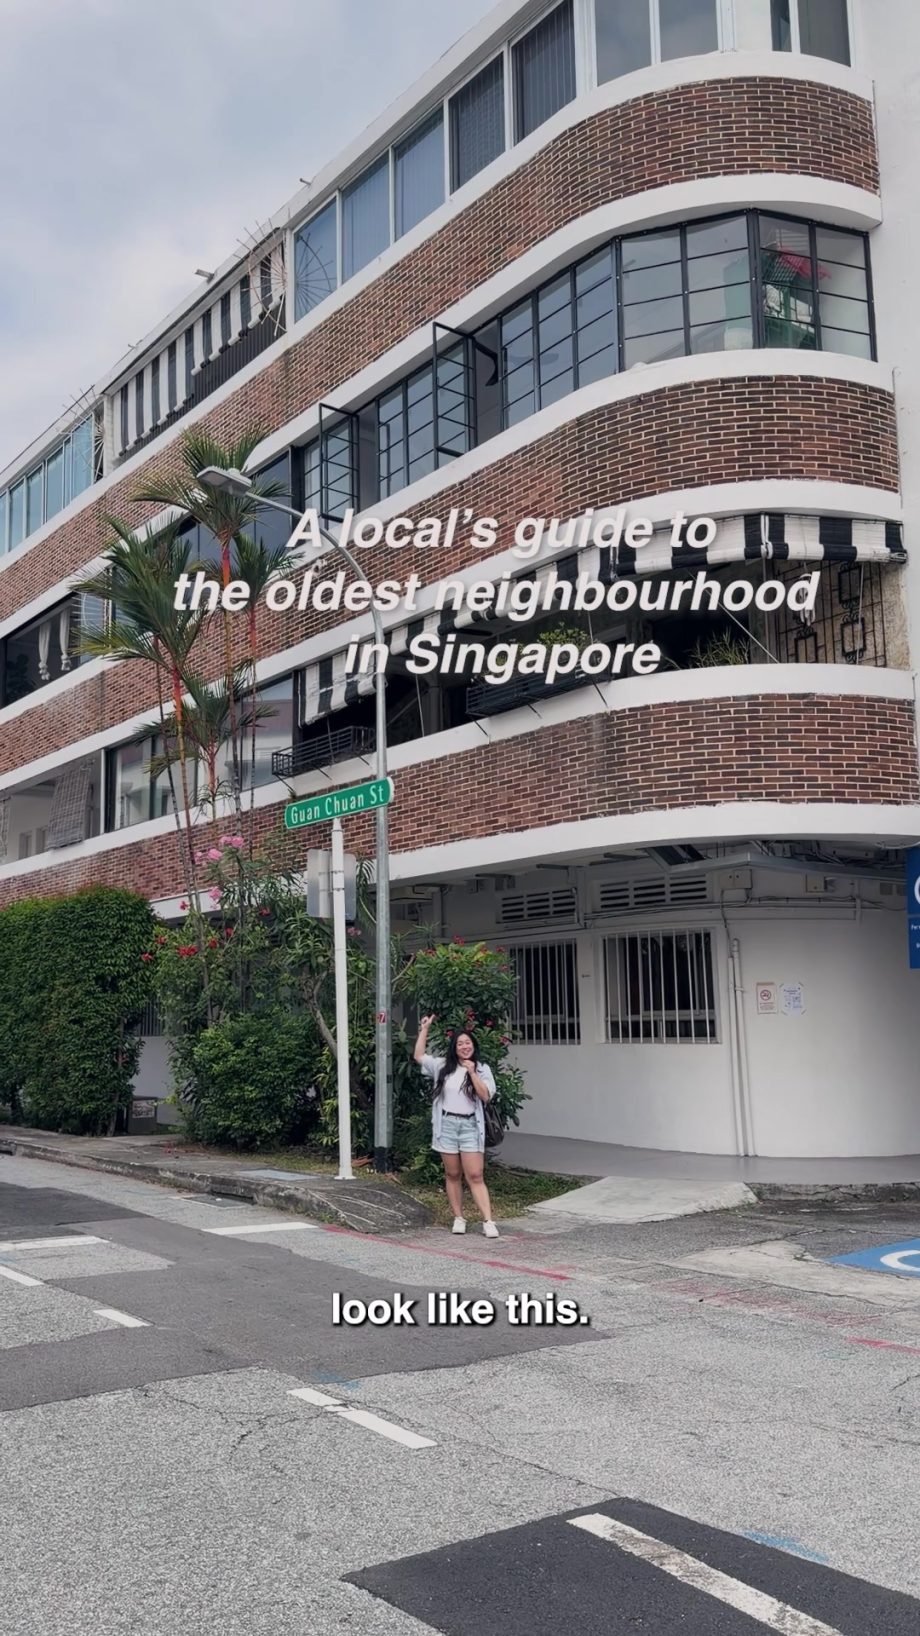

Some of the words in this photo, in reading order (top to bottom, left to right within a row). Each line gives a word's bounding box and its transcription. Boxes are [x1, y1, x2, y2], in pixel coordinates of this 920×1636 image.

[291, 806, 320, 824] Guan
[325, 795, 364, 816] Chuan
[370, 785, 384, 804] St
